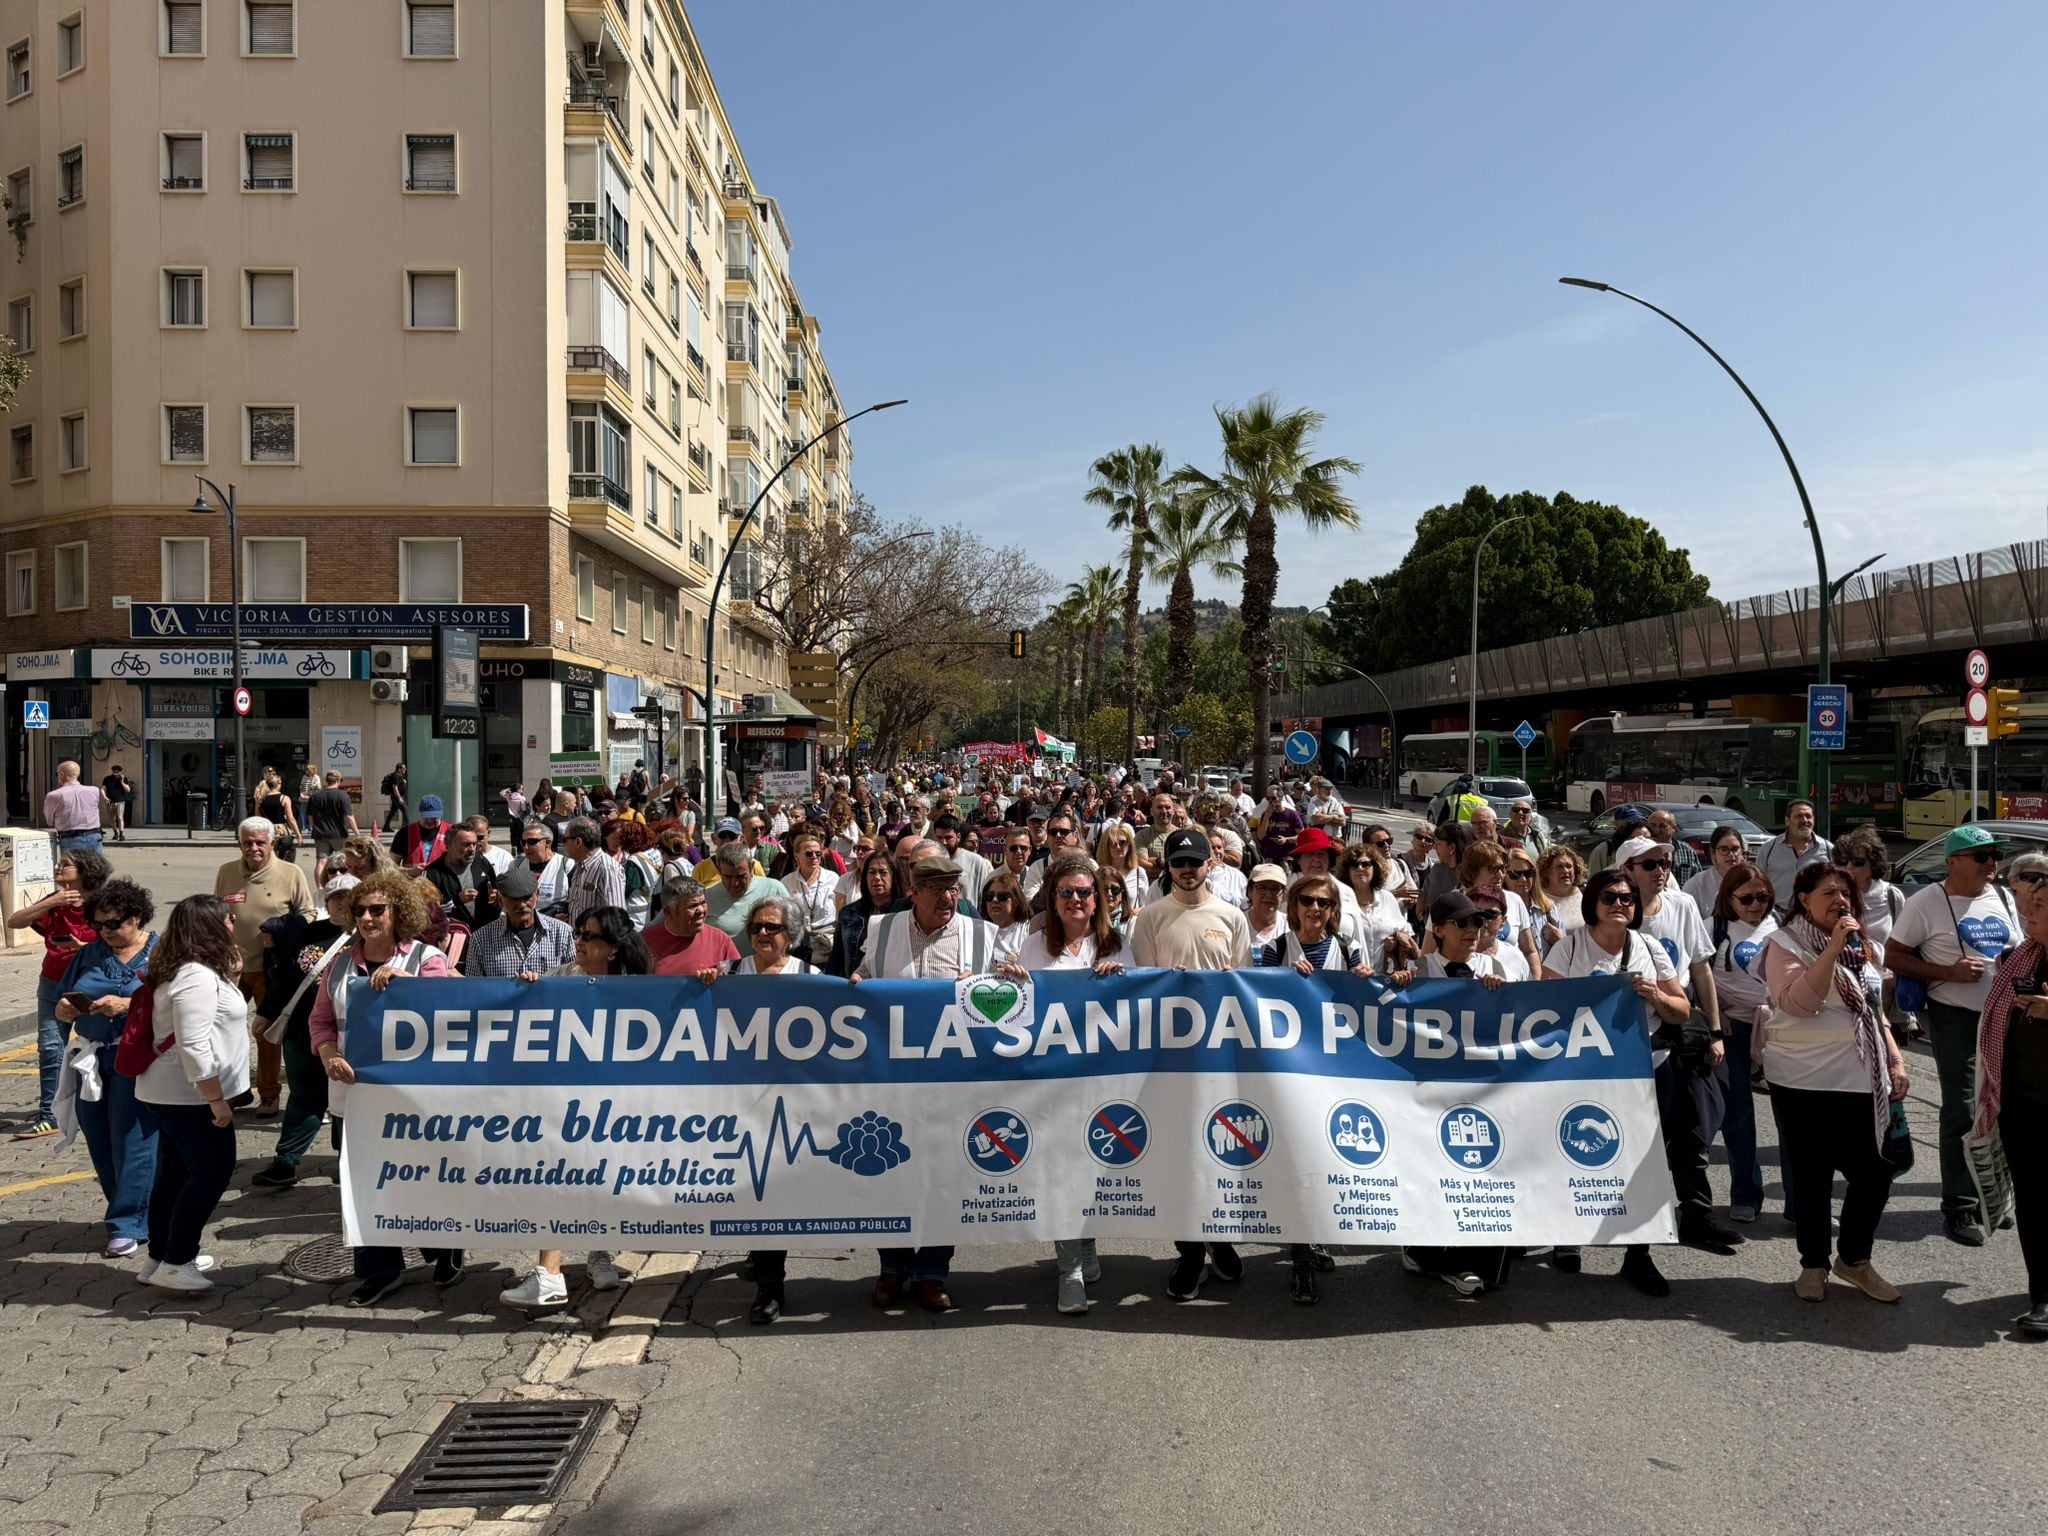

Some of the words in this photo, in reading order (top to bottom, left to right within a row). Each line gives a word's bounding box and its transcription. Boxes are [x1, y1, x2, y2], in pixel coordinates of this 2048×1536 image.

[308, 607, 393, 623] GESTIÓN
[411, 608, 510, 623] ASESORES
[16, 654, 60, 669] SOHO.JMA
[194, 668, 218, 676] BIKE
[1972, 663, 1985, 676] 20
[1821, 714, 1834, 722] 30
[444, 718, 476, 734] 12:23
[747, 727, 785, 737] REFRESCOS
[772, 772, 799, 780] SANIDAD
[1970, 931, 2004, 939] SANIDAD
[381, 1004, 868, 1062] DEFENDAMOS
[888, 1004, 977, 1059] LA
[992, 996, 1302, 1058] SANIDAD
[1321, 988, 1615, 1061] PÚBLICA
[382, 1112, 543, 1143] marea
[561, 1098, 741, 1144] blanca
[376, 1160, 431, 1190] por
[437, 1157, 467, 1184] la
[474, 1158, 608, 1186] sanidad
[612, 1157, 737, 1196] pública
[1096, 1176, 1112, 1188] No
[1115, 1179, 1122, 1187] a
[1125, 1176, 1141, 1187] los
[1328, 1174, 1350, 1185] Más
[1353, 1175, 1398, 1187] Personal
[1568, 1177, 1625, 1188] Asistencia
[979, 1184, 995, 1195] No
[998, 1186, 1005, 1194] a
[1009, 1183, 1018, 1194] la
[1217, 1178, 1234, 1189] No
[1237, 1181, 1244, 1189] a
[1247, 1178, 1263, 1189] las
[1439, 1178, 1461, 1189] Más
[1463, 1181, 1470, 1191] y
[1473, 1179, 1515, 1192] Mejores
[674, 1189, 736, 1204] MÁLAGA
[1095, 1190, 1143, 1202] Recortes
[1224, 1193, 1257, 1204] Listas
[1339, 1191, 1346, 1203] y
[1350, 1190, 1391, 1202] Mejores
[1445, 1193, 1515, 1204] Instalaciones
[1573, 1191, 1624, 1202] Sanitaria
[962, 1196, 1035, 1209] Privatización
[1082, 1207, 1096, 1217] en
[1099, 1205, 1109, 1216] la
[1112, 1205, 1156, 1217] Sanidad
[1212, 1207, 1226, 1218] de
[1229, 1209, 1267, 1221] espera
[1333, 1204, 1399, 1216] Condiciones
[1453, 1209, 1460, 1220] y
[1462, 1207, 1512, 1218] Servicios
[1574, 1205, 1627, 1217] Universal
[961, 1212, 975, 1224] de
[978, 1212, 987, 1223] la
[991, 1210, 1036, 1222] Sanidad
[374, 1214, 462, 1233] Trabajador@s
[474, 1218, 537, 1233] Usuari@s
[549, 1219, 608, 1235] Vecin@s
[620, 1219, 704, 1235] Estudiantes
[715, 1221, 758, 1234] JUNT@S
[761, 1221, 786, 1232] POR
[788, 1220, 802, 1231] LA
[805, 1219, 856, 1231] SANIDAD
[859, 1217, 907, 1231] PÚBLICA
[1202, 1222, 1282, 1234] Interminables
[1339, 1219, 1353, 1230] de
[1355, 1219, 1397, 1233] Trabajo
[1457, 1221, 1513, 1232] Sanitarios
